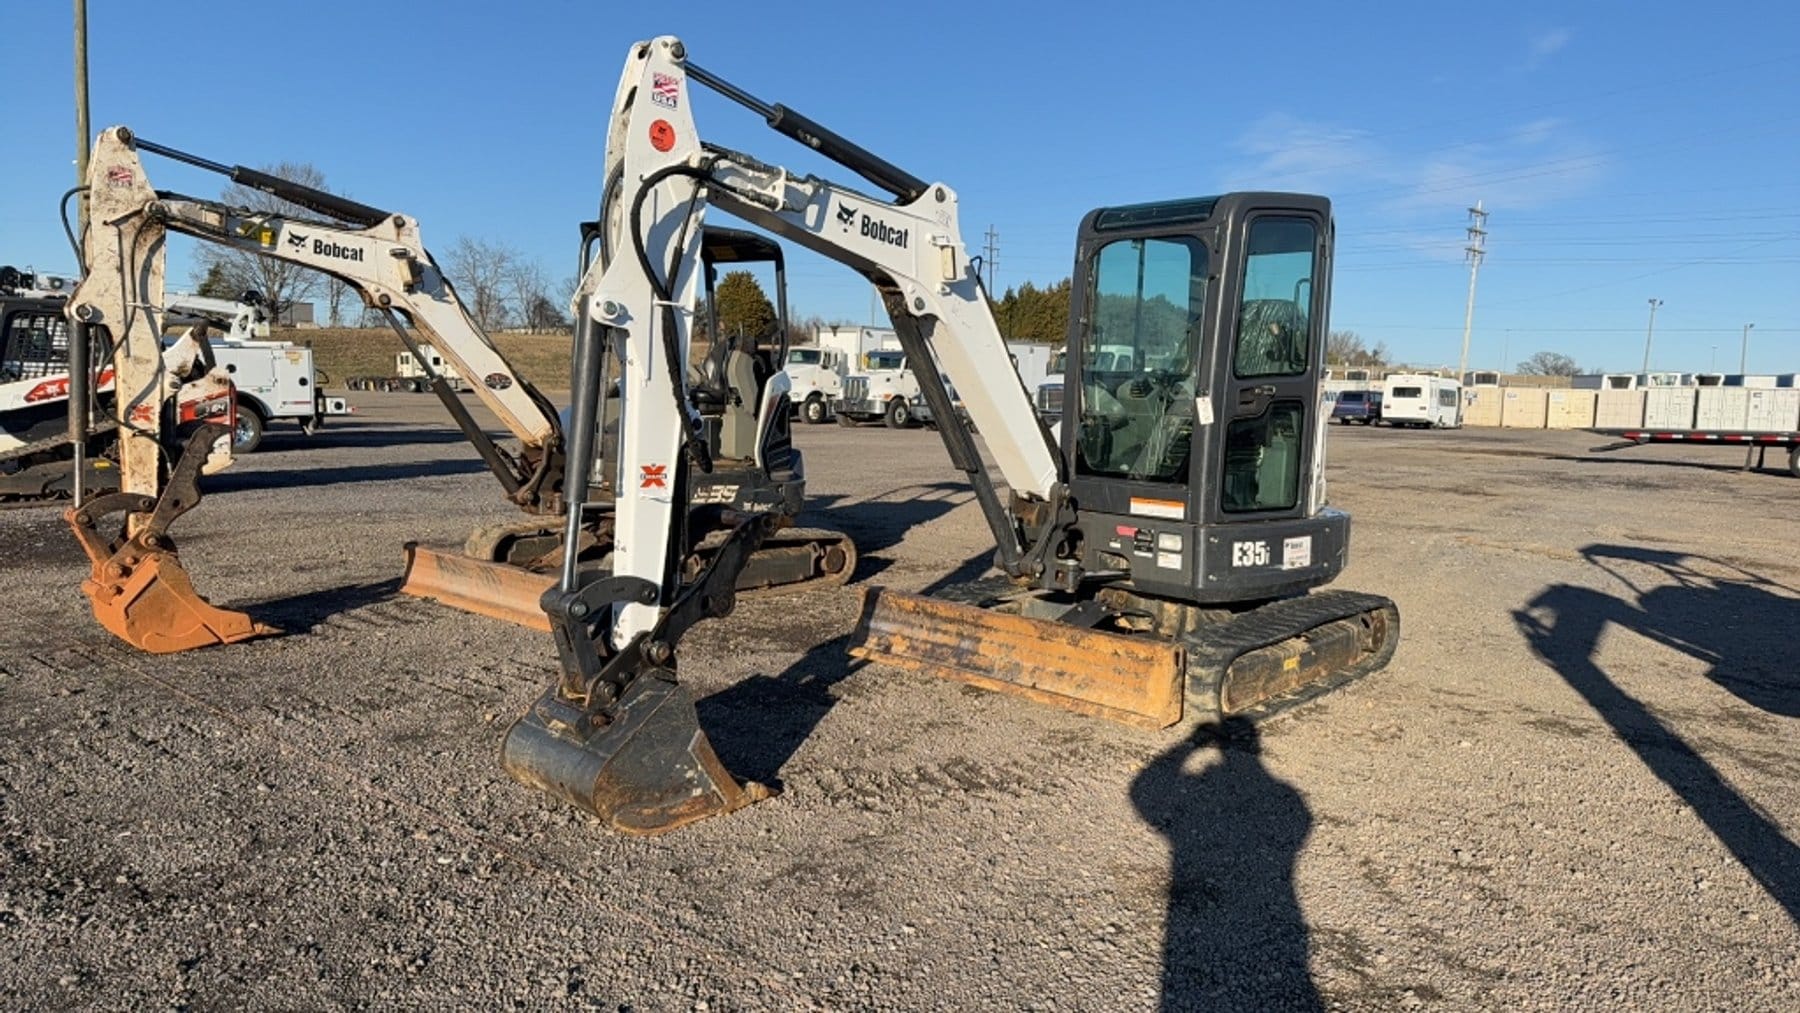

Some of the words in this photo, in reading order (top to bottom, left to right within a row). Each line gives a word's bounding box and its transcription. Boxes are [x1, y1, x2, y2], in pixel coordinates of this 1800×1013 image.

[861, 214, 909, 249] Bobcat
[313, 239, 364, 262] Bobcat
[1232, 541, 1270, 567] E35i
